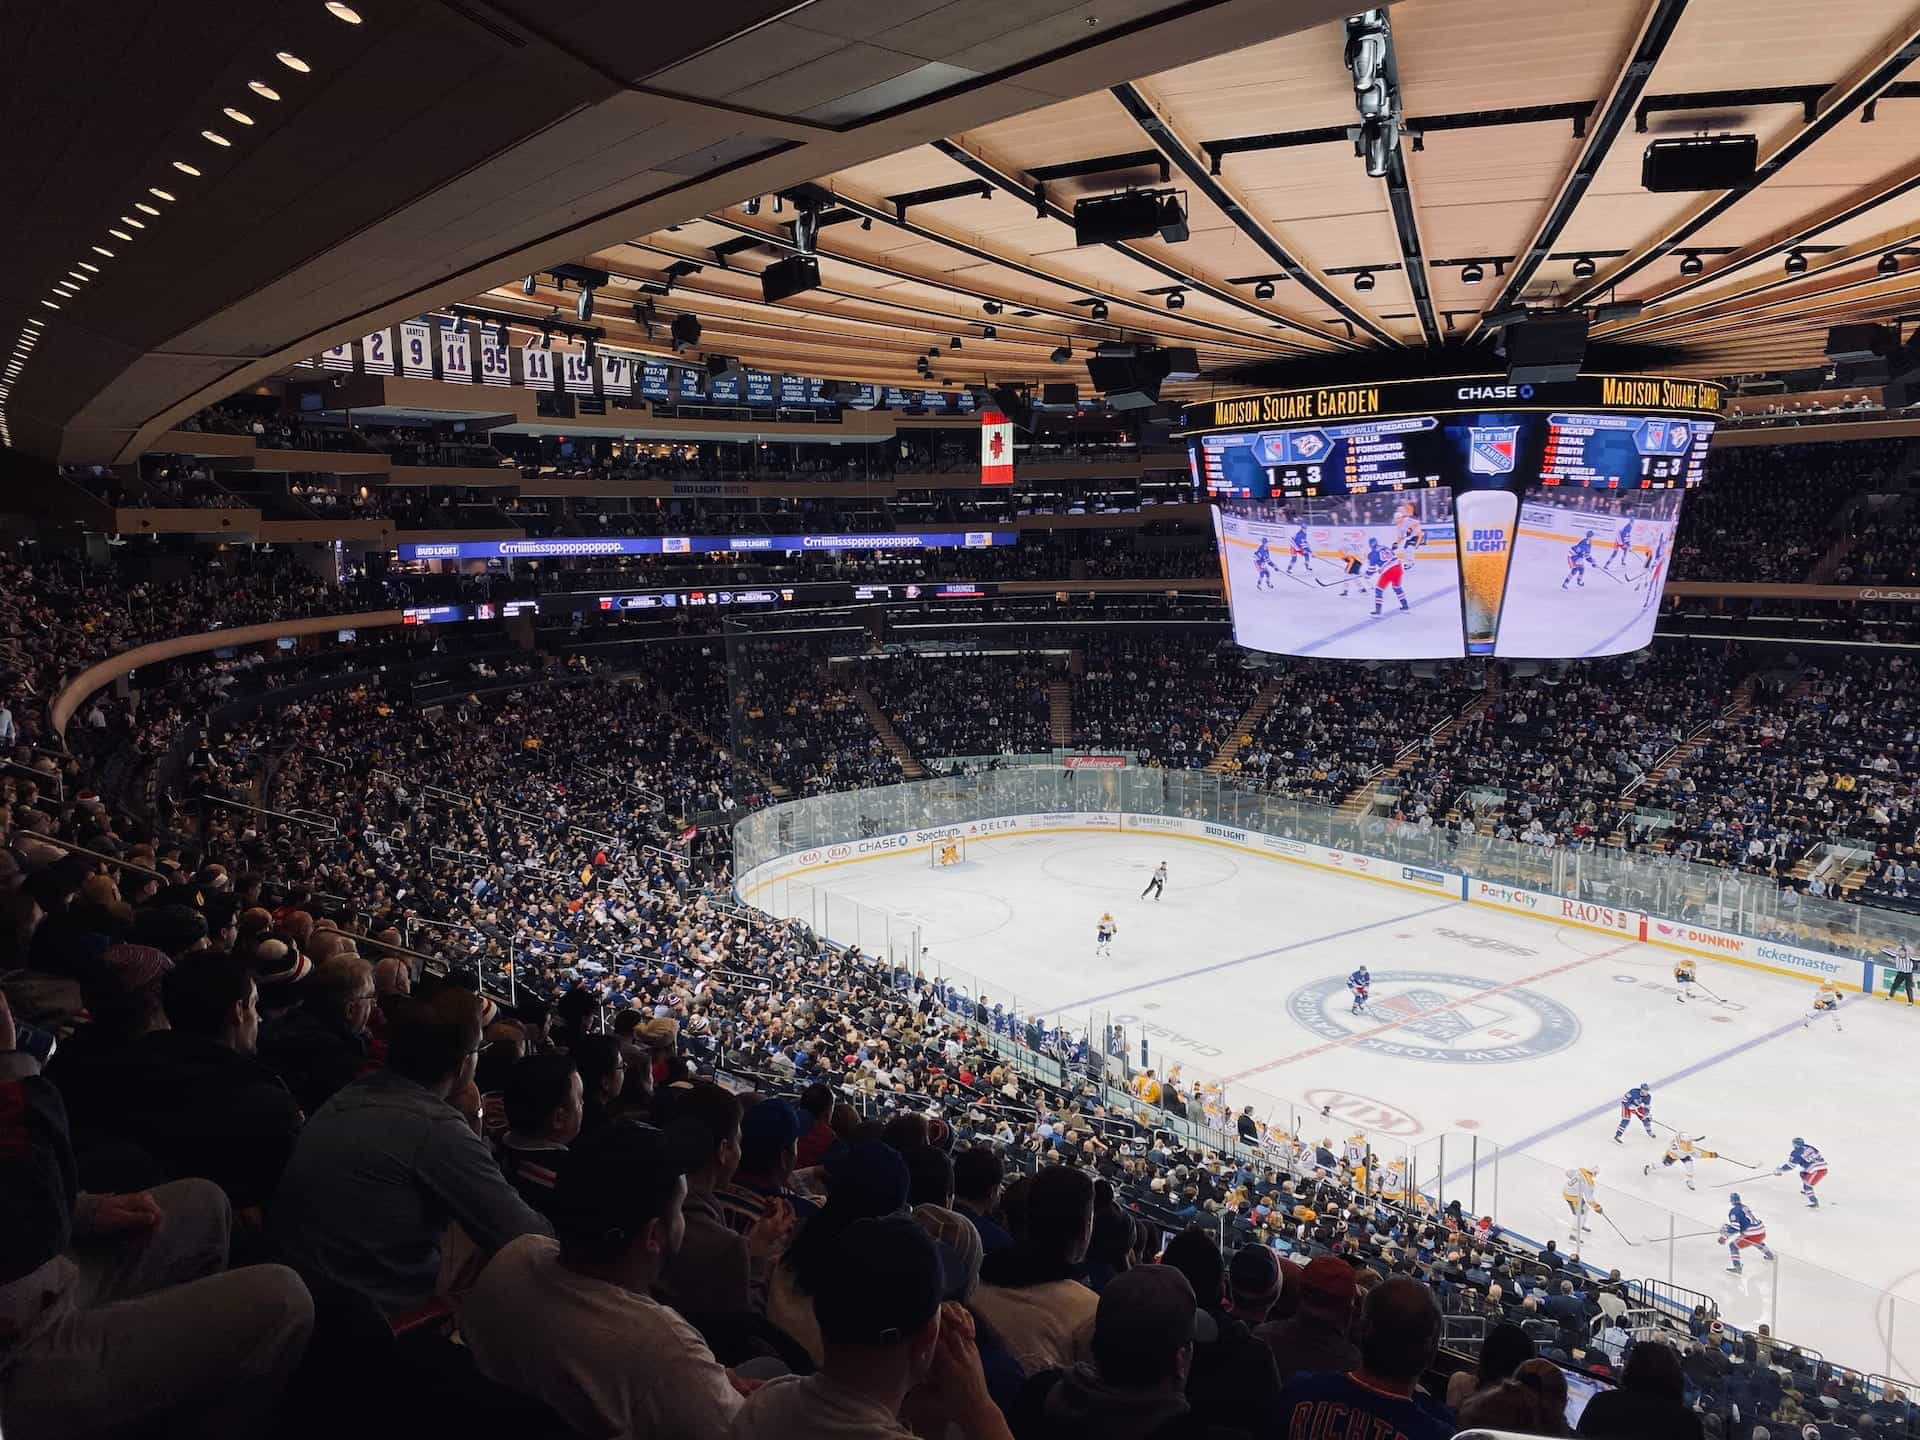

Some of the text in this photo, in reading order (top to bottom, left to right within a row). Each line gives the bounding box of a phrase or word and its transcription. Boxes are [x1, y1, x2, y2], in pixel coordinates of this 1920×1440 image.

[371, 333, 384, 361] 2
[410, 339, 423, 365] 9
[447, 343, 466, 371] 11
[483, 347, 507, 374] 35
[528, 352, 548, 378] 11
[567, 356, 589, 381] 19
[1457, 385, 1517, 400] CHASE
[1603, 378, 1660, 405] MADISON
[1662, 379, 1697, 408] SQUARE
[1214, 388, 1379, 425] MADISON SQUARE GARDEN
[1376, 420, 1423, 432] PREDATORS
[1474, 431, 1513, 441] NEW YORK
[1479, 443, 1511, 469] RANGERS
[1307, 465, 1322, 483] 3
[1642, 457, 1651, 475] 1
[1670, 458, 1681, 476] 3
[1265, 468, 1276, 485] 1
[1472, 529, 1504, 541] BUD
[417, 546, 457, 556] BUD LIGHT
[1466, 540, 1507, 552] LIGHT
[680, 594, 687, 606] 1
[707, 593, 717, 604] 3
[1070, 756, 1122, 768] Budweiser
[980, 819, 1017, 832] DELTA
[1205, 825, 1246, 842] BUD LIGHT
[916, 828, 959, 843] Spectrum
[830, 845, 849, 858] KIA
[858, 837, 896, 853] CHASE
[802, 851, 820, 864] KIA
[1561, 900, 1614, 927] RAO'S
[1688, 929, 1745, 951] DUNKIN'
[1757, 946, 1841, 974] ticketmaster
